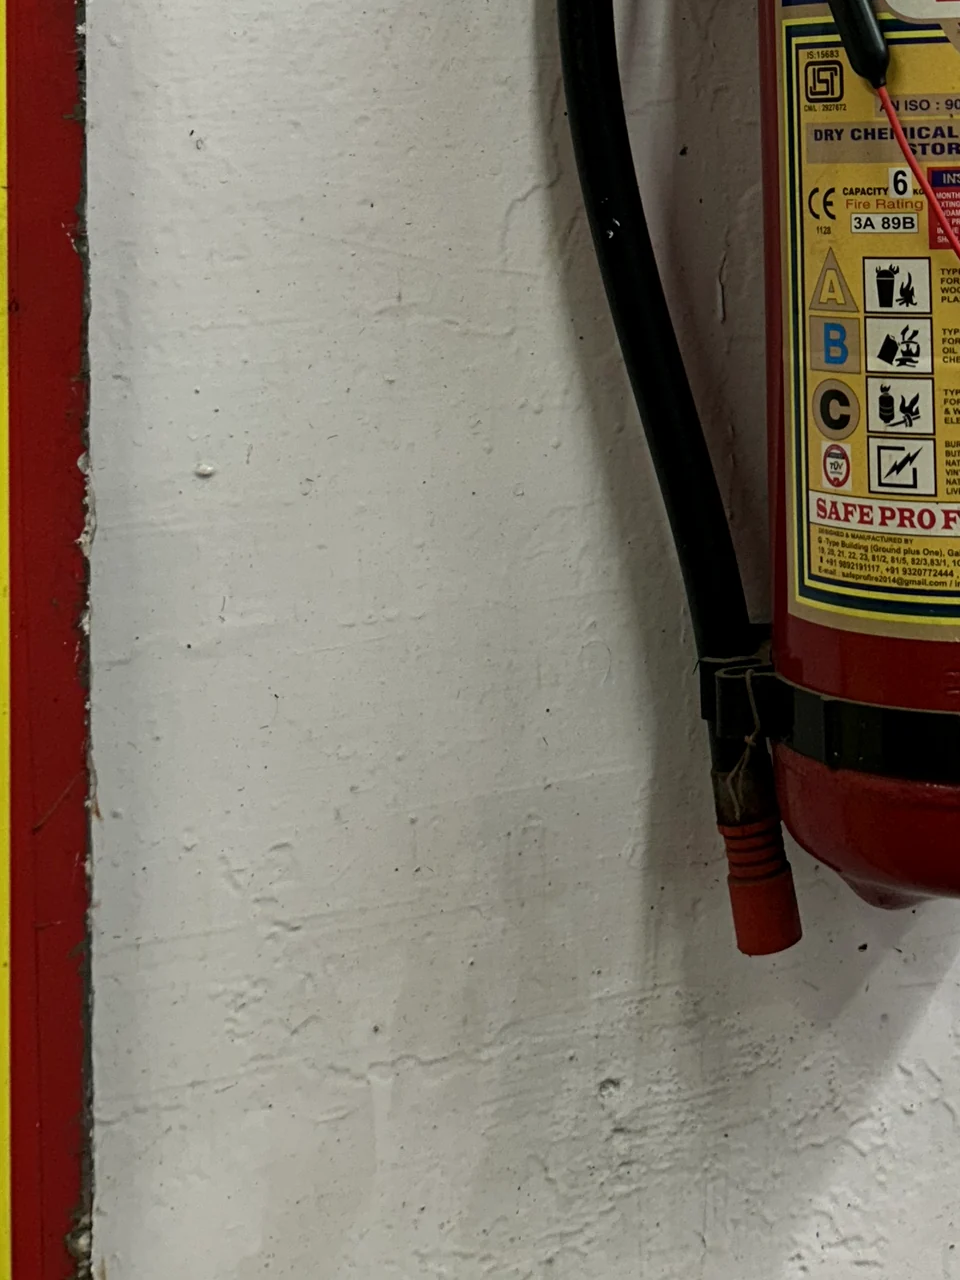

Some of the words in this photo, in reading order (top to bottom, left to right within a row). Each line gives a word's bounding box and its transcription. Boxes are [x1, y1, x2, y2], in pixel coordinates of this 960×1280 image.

[904, 99, 931, 112] ISO
[813, 128, 844, 142] DRY
[842, 187, 888, 196] CAPACITY
[893, 170, 908, 196] 6
[845, 199, 871, 209] Fire
[876, 199, 924, 211] Rating
[854, 216, 875, 230] 3A
[881, 216, 915, 230] 89B
[819, 269, 847, 305] A
[823, 322, 848, 365] B
[820, 389, 850, 430] C
[816, 497, 874, 526] SAFE
[878, 505, 936, 530] PRO
[841, 538, 869, 553] Building
[869, 543, 901, 555] (Ground
[902, 546, 921, 557] plus
